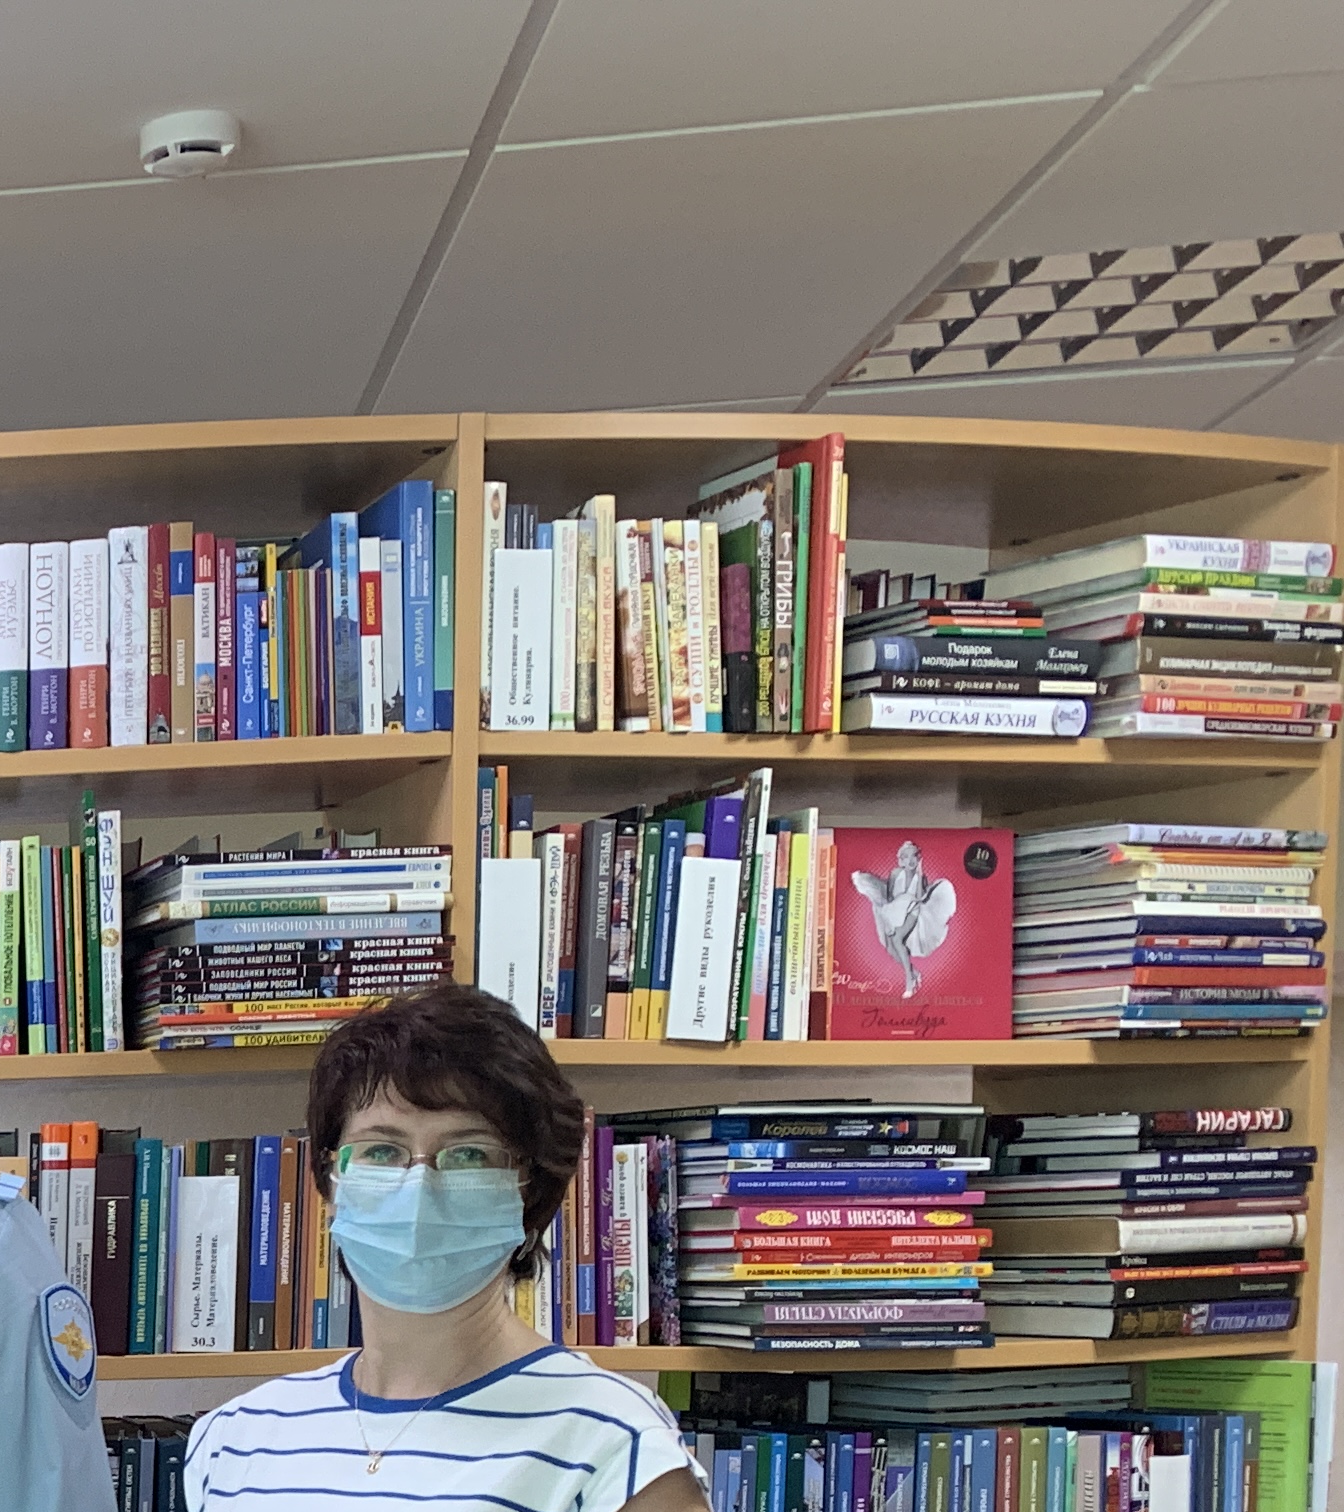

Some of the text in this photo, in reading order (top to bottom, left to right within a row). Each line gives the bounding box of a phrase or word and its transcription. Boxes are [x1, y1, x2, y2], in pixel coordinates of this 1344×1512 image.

[36, 552, 54, 660] ЛОНДОН
[201, 587, 211, 638] ВАТИКАН
[219, 618, 232, 667] МОСКВА
[243, 604, 255, 703] Санкт-Петербург
[508, 586, 520, 705] Общественное питание.
[523, 648, 534, 705] Кулинария.
[505, 714, 535, 726] 36.99
[908, 709, 1037, 728] РУССКАЯ КУХНЯ
[213, 899, 318, 914] АТЛАС РОССИИ
[594, 832, 612, 940] ДОМОВАЯ РЕЗЬБА
[693, 876, 717, 1028] Другие виды рукоделия
[1196, 1108, 1287, 1133] ГАГАРИН
[894, 1144, 956, 1156] КОСМОС НАШ
[191, 1233, 203, 1328] Сырье. Материалы.
[206, 1234, 219, 1328] Материаловедение.
[191, 1336, 216, 1348] 30.3
